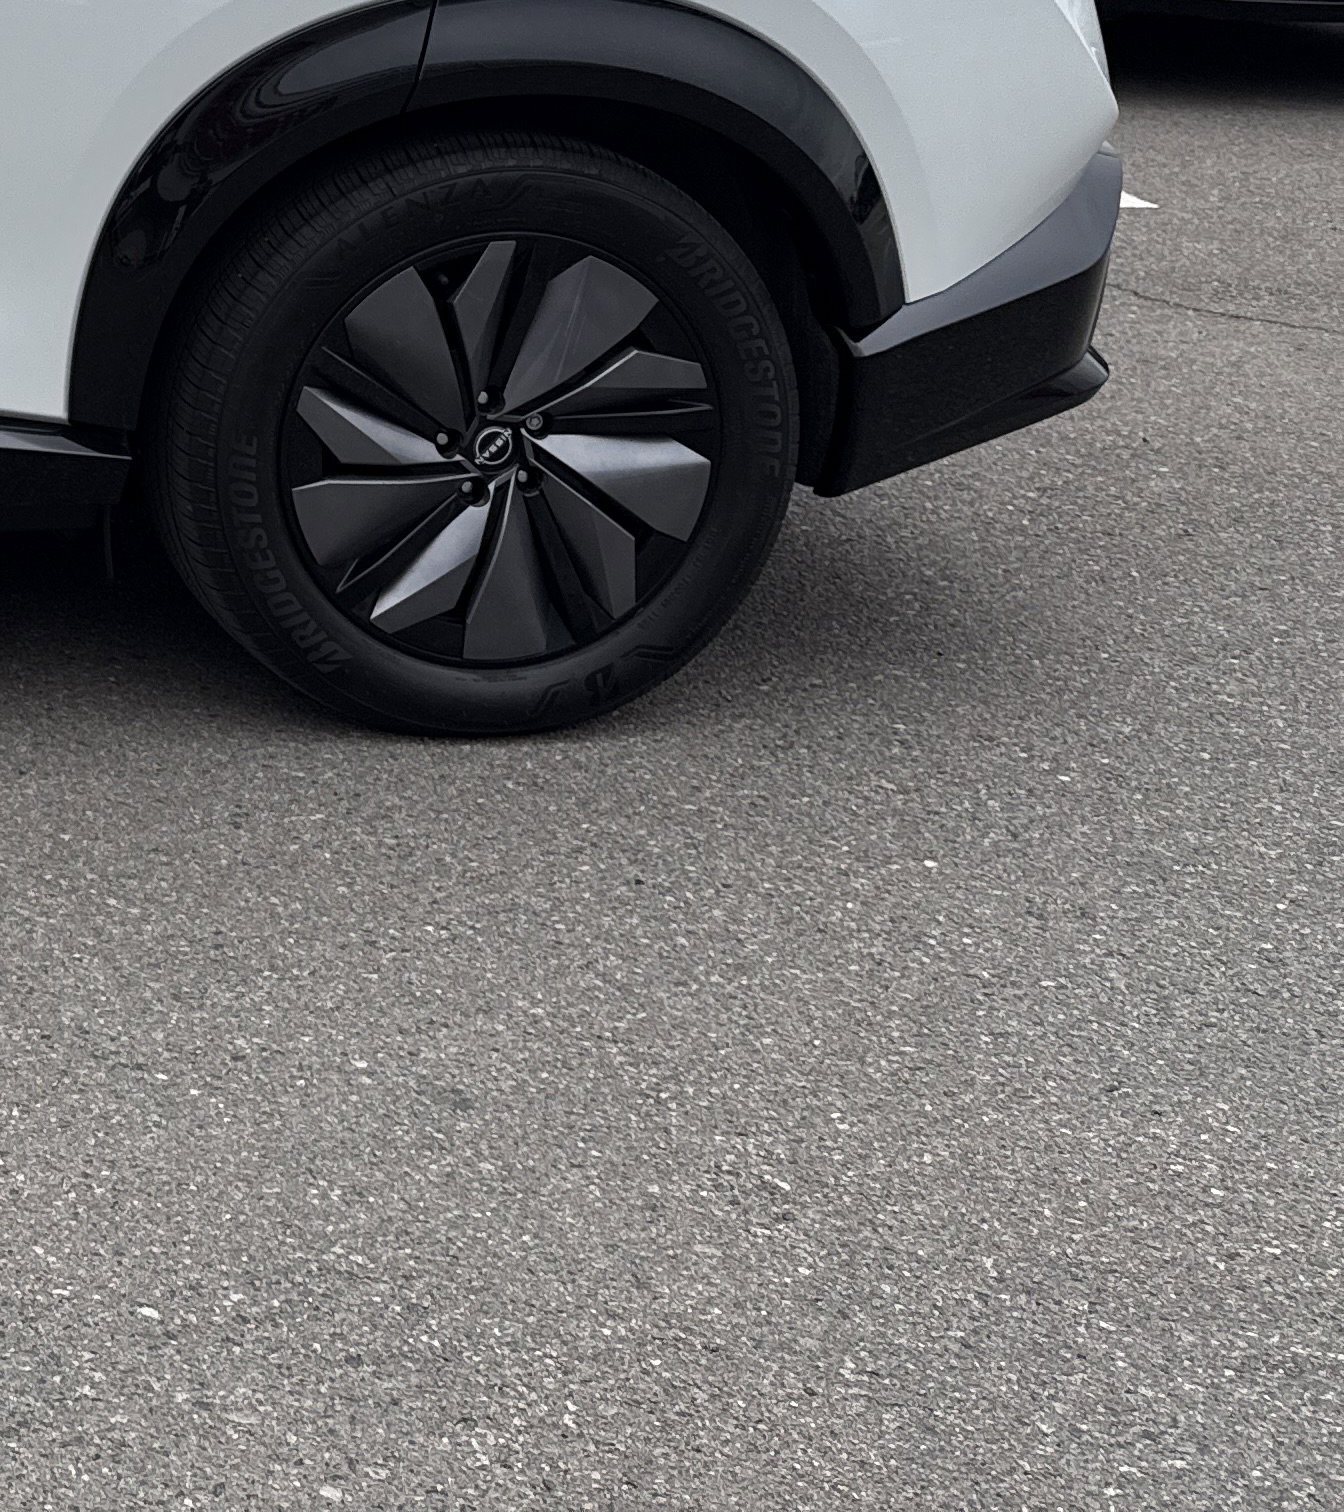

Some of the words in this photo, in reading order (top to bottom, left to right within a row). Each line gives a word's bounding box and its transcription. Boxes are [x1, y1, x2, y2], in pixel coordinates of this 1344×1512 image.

[474, 427, 513, 465] NISSAN
[664, 232, 784, 479] BRIDGESTONE
[227, 430, 354, 675] BRIDGESTONE
